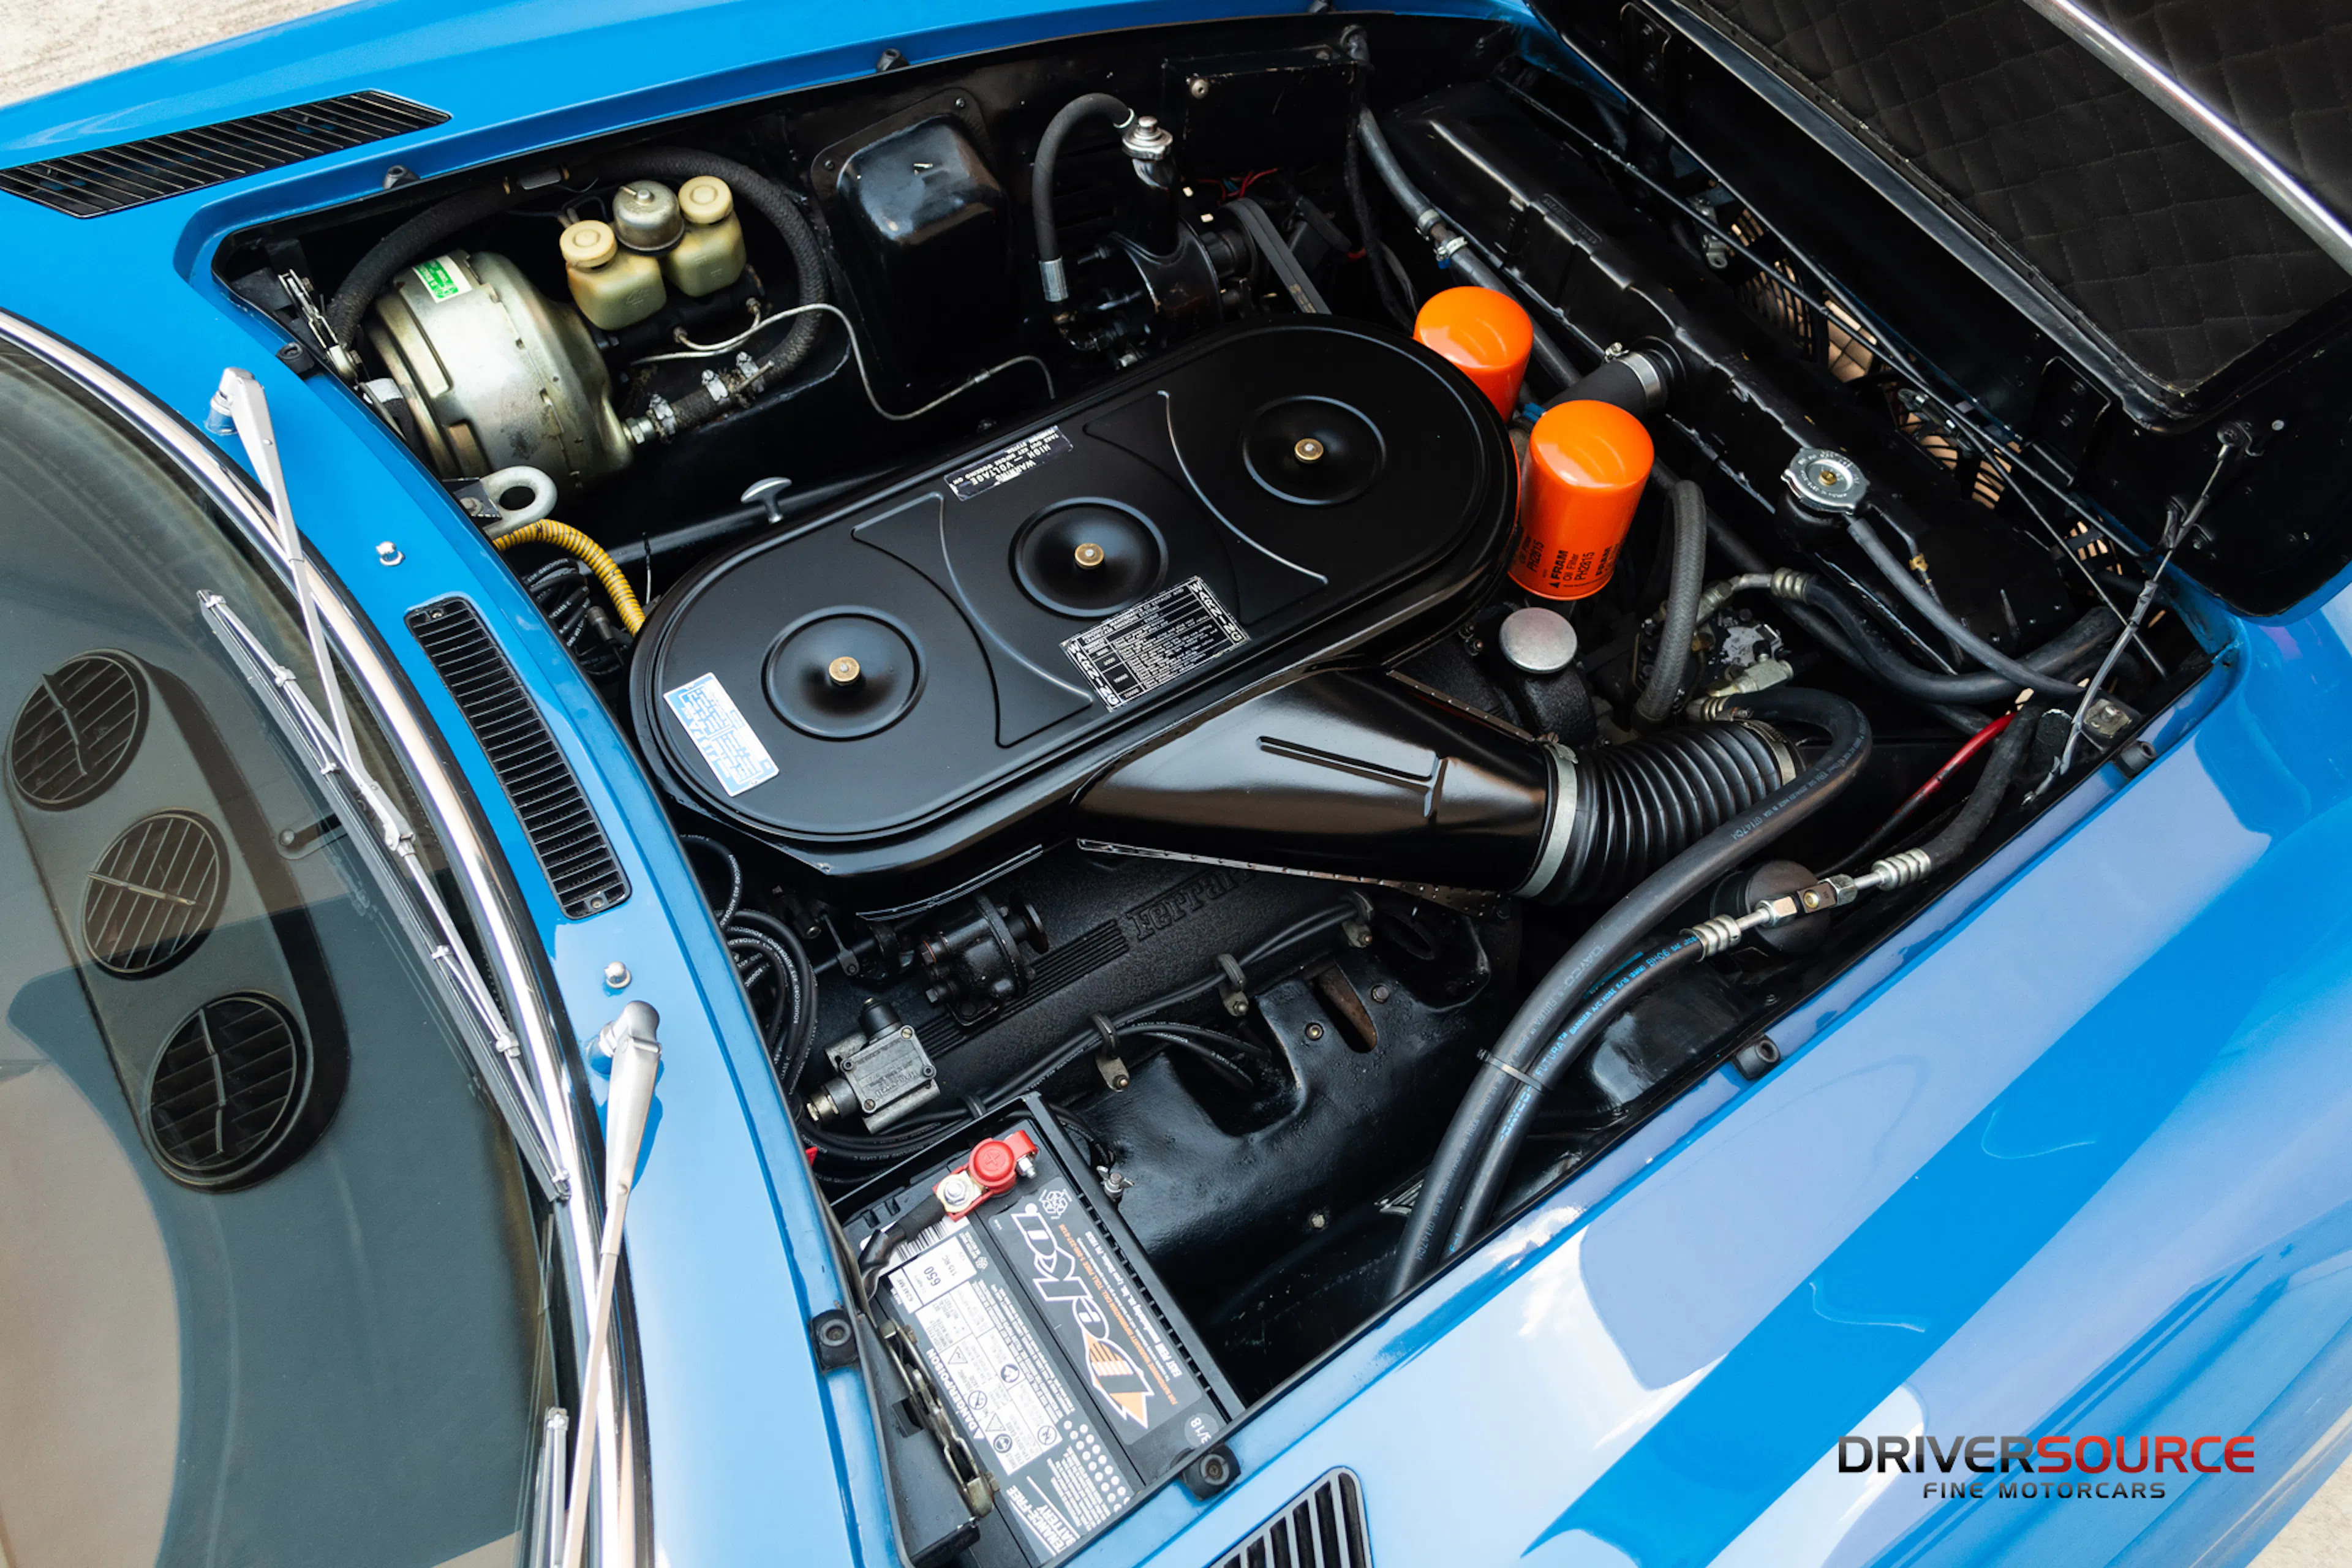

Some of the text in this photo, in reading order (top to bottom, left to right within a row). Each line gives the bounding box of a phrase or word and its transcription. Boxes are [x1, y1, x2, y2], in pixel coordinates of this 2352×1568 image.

[1025, 443, 1051, 459] HIGH
[968, 460, 1014, 486] VOLTAGE
[1551, 550, 1569, 580] FRAM
[1563, 554, 1579, 581] Oil Filter
[1188, 581, 1246, 643] WARNING
[1065, 640, 1121, 707] WARNING
[1567, 1009, 1593, 1036] BARRIER
[1589, 999, 1603, 1012] A/C
[1599, 986, 1618, 1002] HOSE
[921, 1265, 943, 1287] 650
[1090, 1274, 1104, 1291] TOLL
[1164, 1357, 1183, 1379] EAST
[924, 1346, 979, 1432] DANGER/POISON
